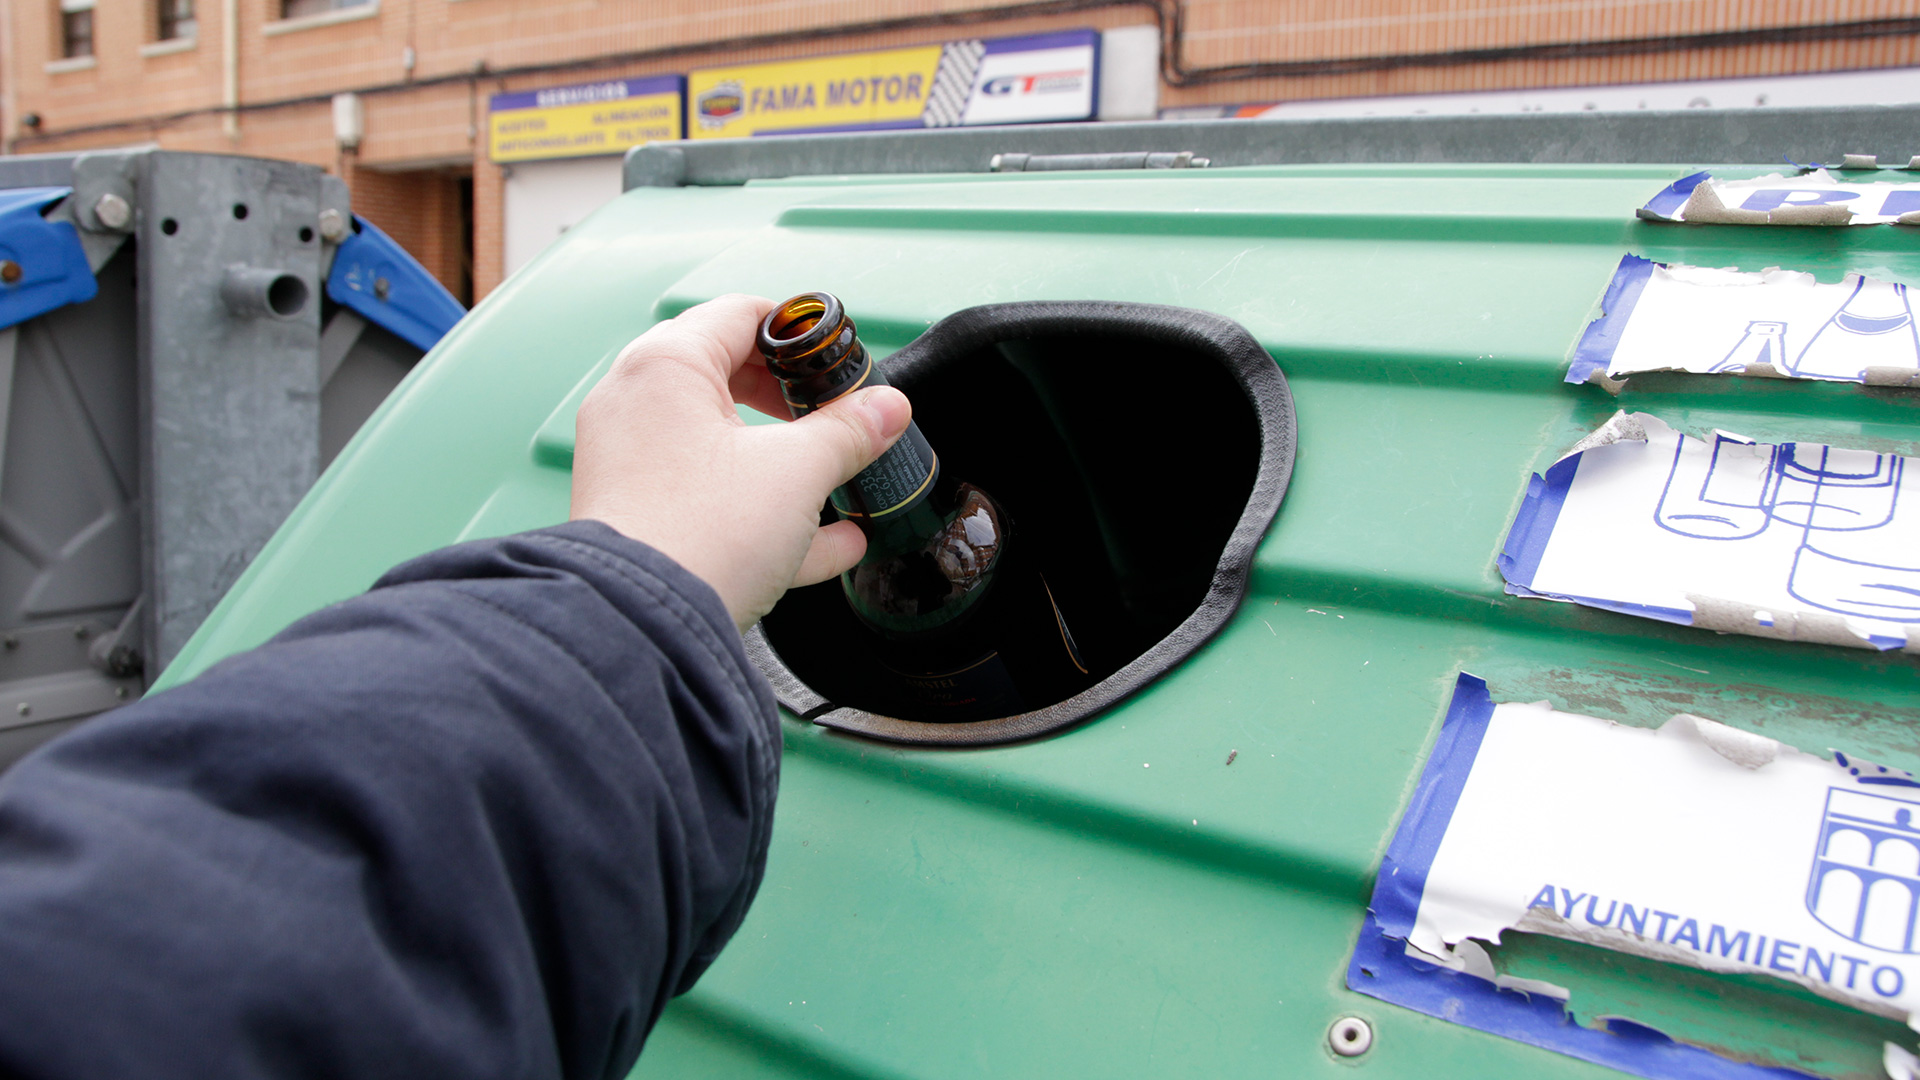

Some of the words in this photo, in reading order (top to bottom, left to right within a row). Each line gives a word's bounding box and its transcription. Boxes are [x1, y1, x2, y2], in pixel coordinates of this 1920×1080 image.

[536, 82, 628, 108] SERVICIOS
[750, 82, 816, 113] FAMA
[825, 73, 923, 108] MOTOR
[981, 75, 1036, 95] GT
[616, 126, 670, 142] FILTROS
[1526, 884, 1906, 998] AYUNTAMIENTO
